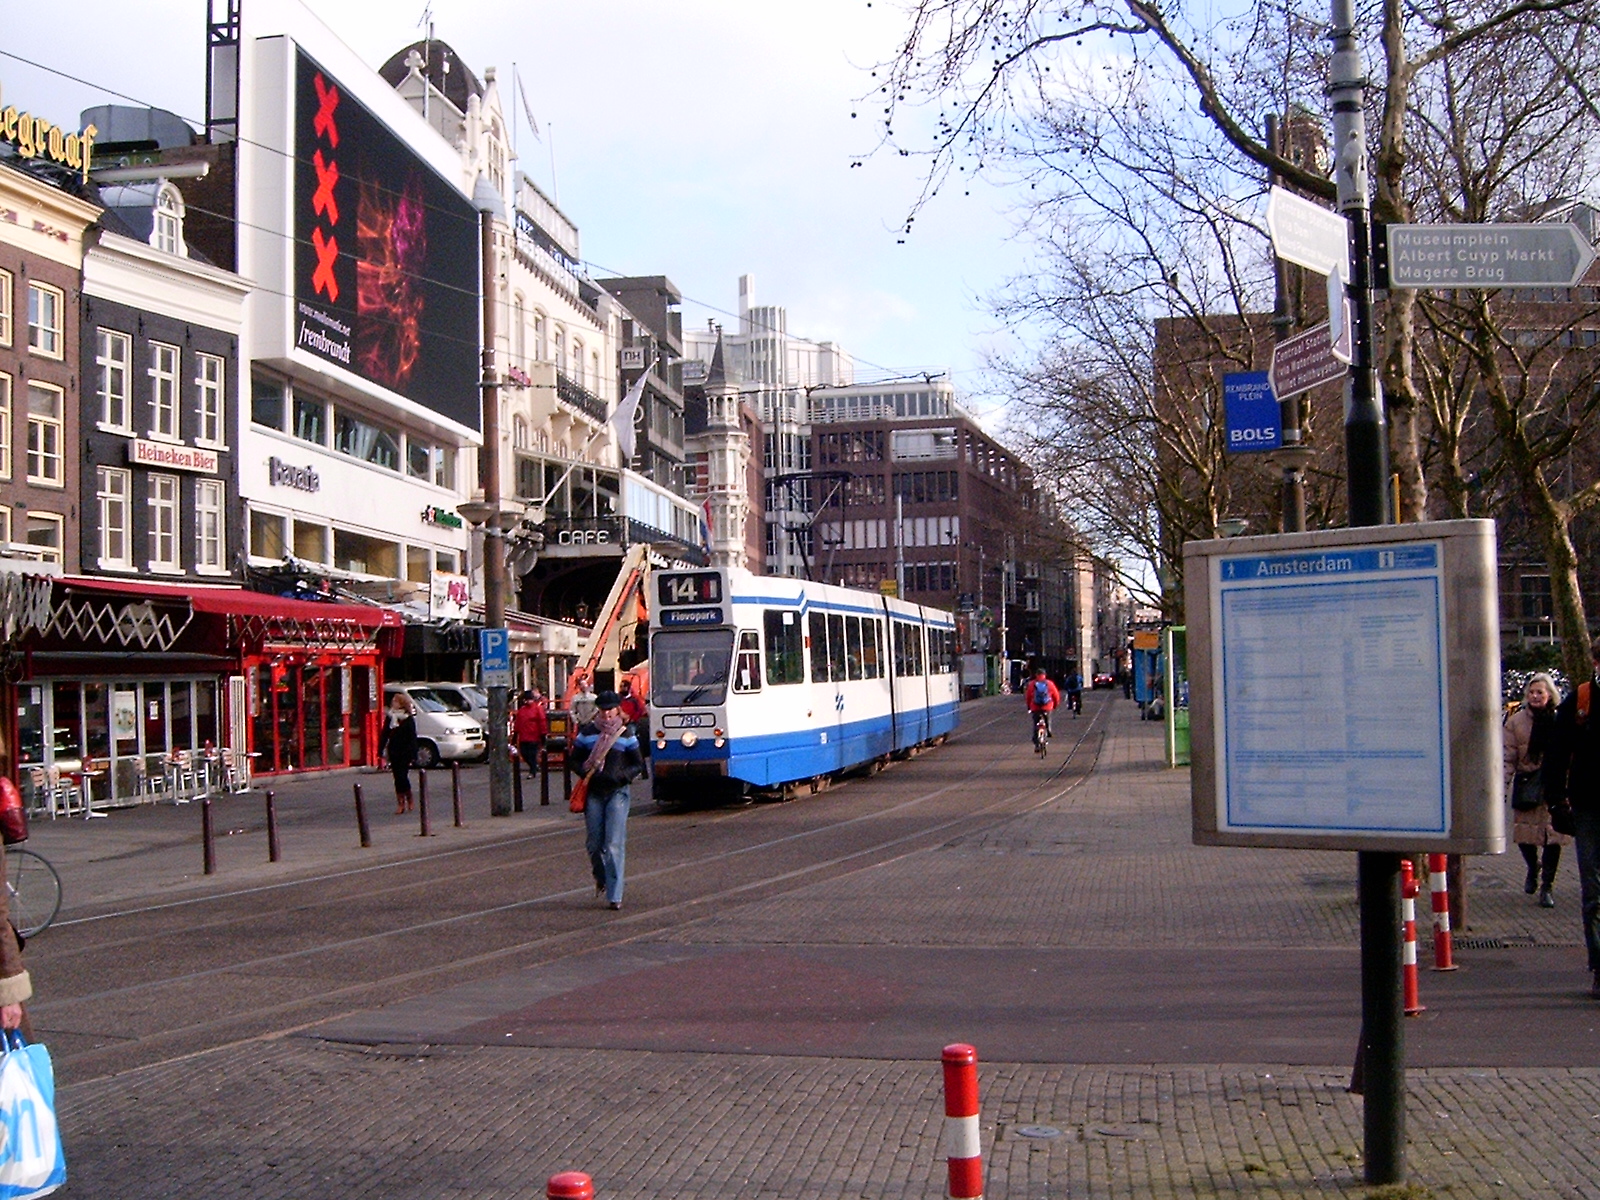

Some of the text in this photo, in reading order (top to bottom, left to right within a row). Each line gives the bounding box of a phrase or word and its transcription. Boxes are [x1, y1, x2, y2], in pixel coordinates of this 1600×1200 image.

[0, 104, 98, 185] egraaf
[1398, 233, 1509, 247] Museumplein
[1398, 249, 1554, 264] Albert Cuyp Markt
[1399, 265, 1505, 281] Magere Brug
[1225, 383, 1270, 393] REMBRAND
[1231, 427, 1275, 441] BOLS
[137, 443, 216, 470] Heineken Bier
[558, 530, 609, 545] CAFE
[1256, 555, 1352, 576] Amsterdam
[667, 577, 698, 603] 14
[487, 632, 502, 654] P
[680, 714, 702, 727] 790
